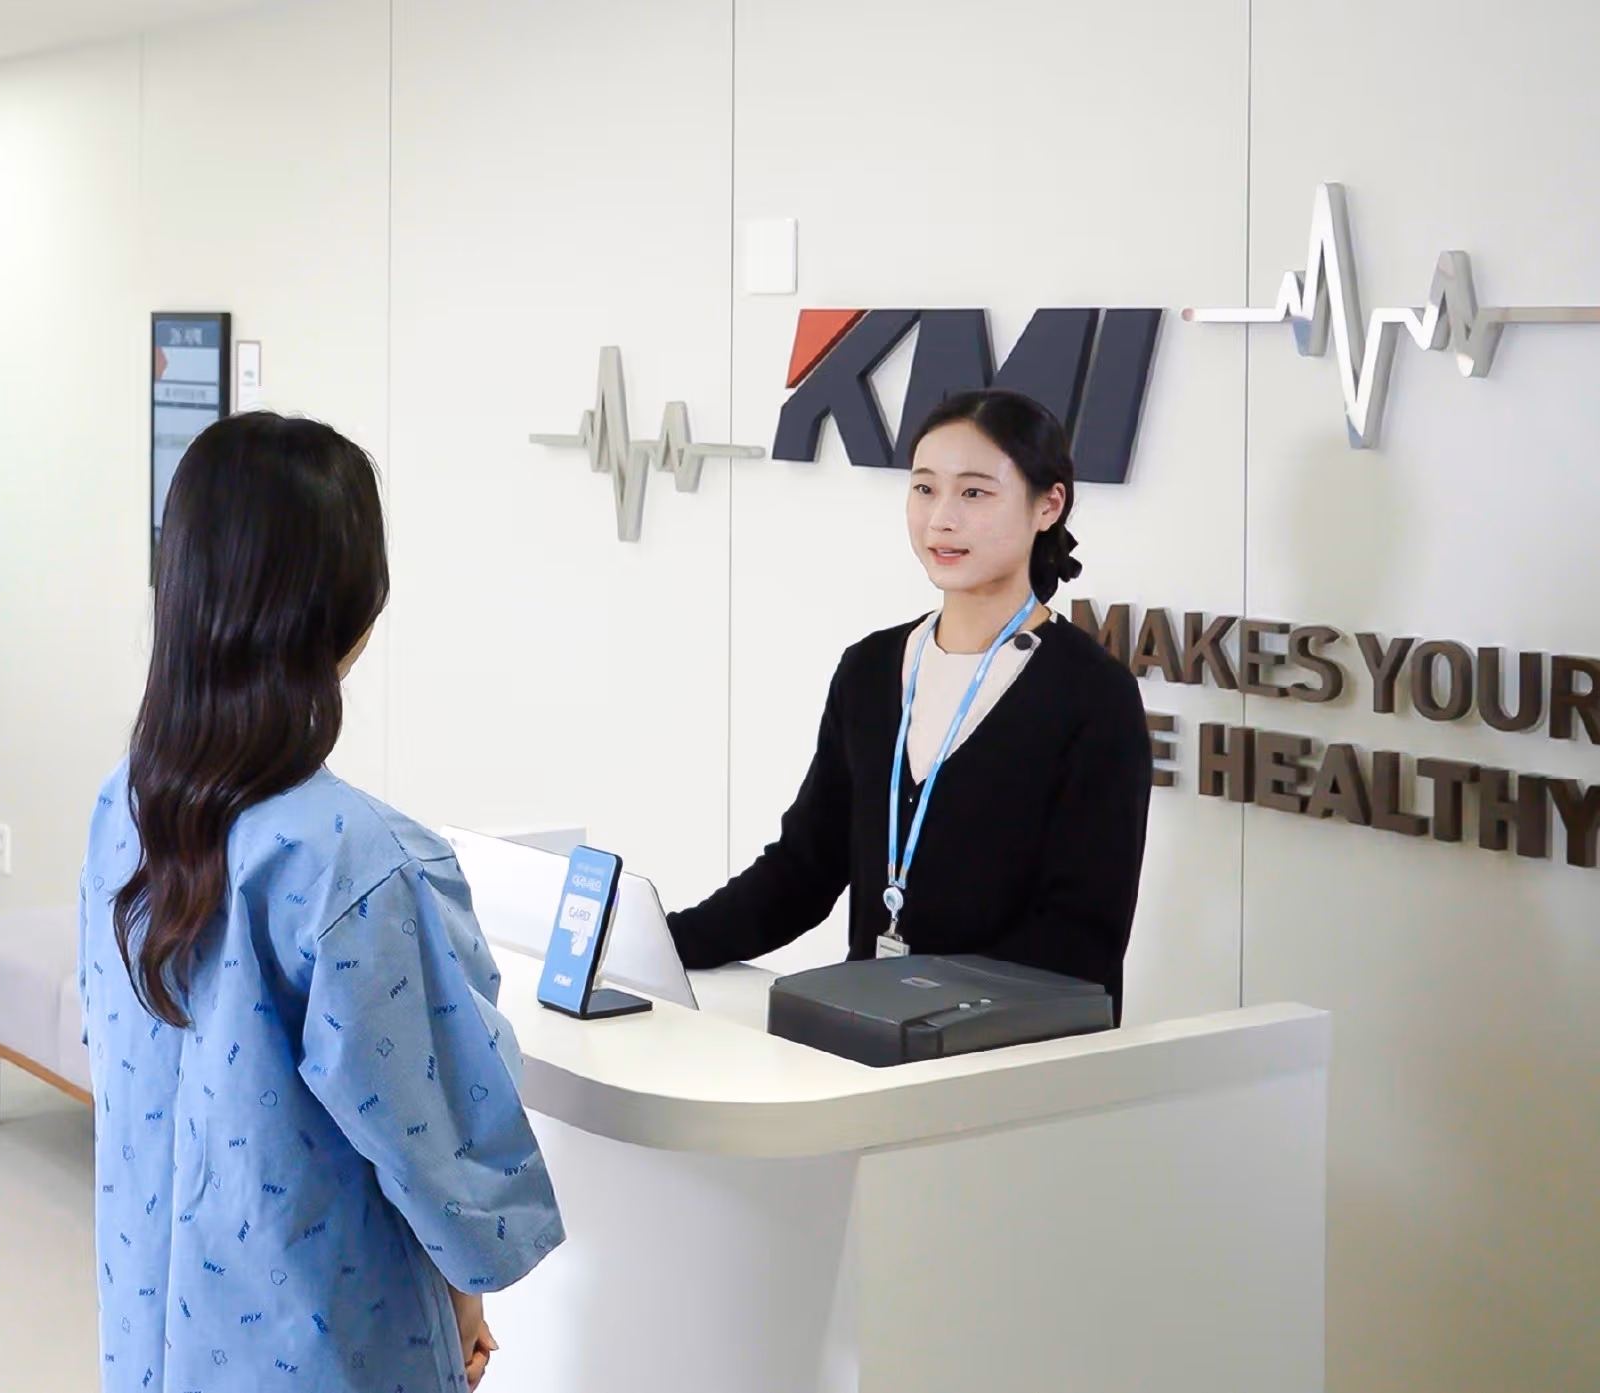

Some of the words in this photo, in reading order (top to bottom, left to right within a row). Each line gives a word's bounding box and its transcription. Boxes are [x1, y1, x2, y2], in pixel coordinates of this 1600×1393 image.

[772, 308, 1167, 484] KMI
[1070, 597, 1344, 702] MAKES
[1354, 631, 1600, 746] YOUR
[1199, 721, 1600, 868] HEALTHY
